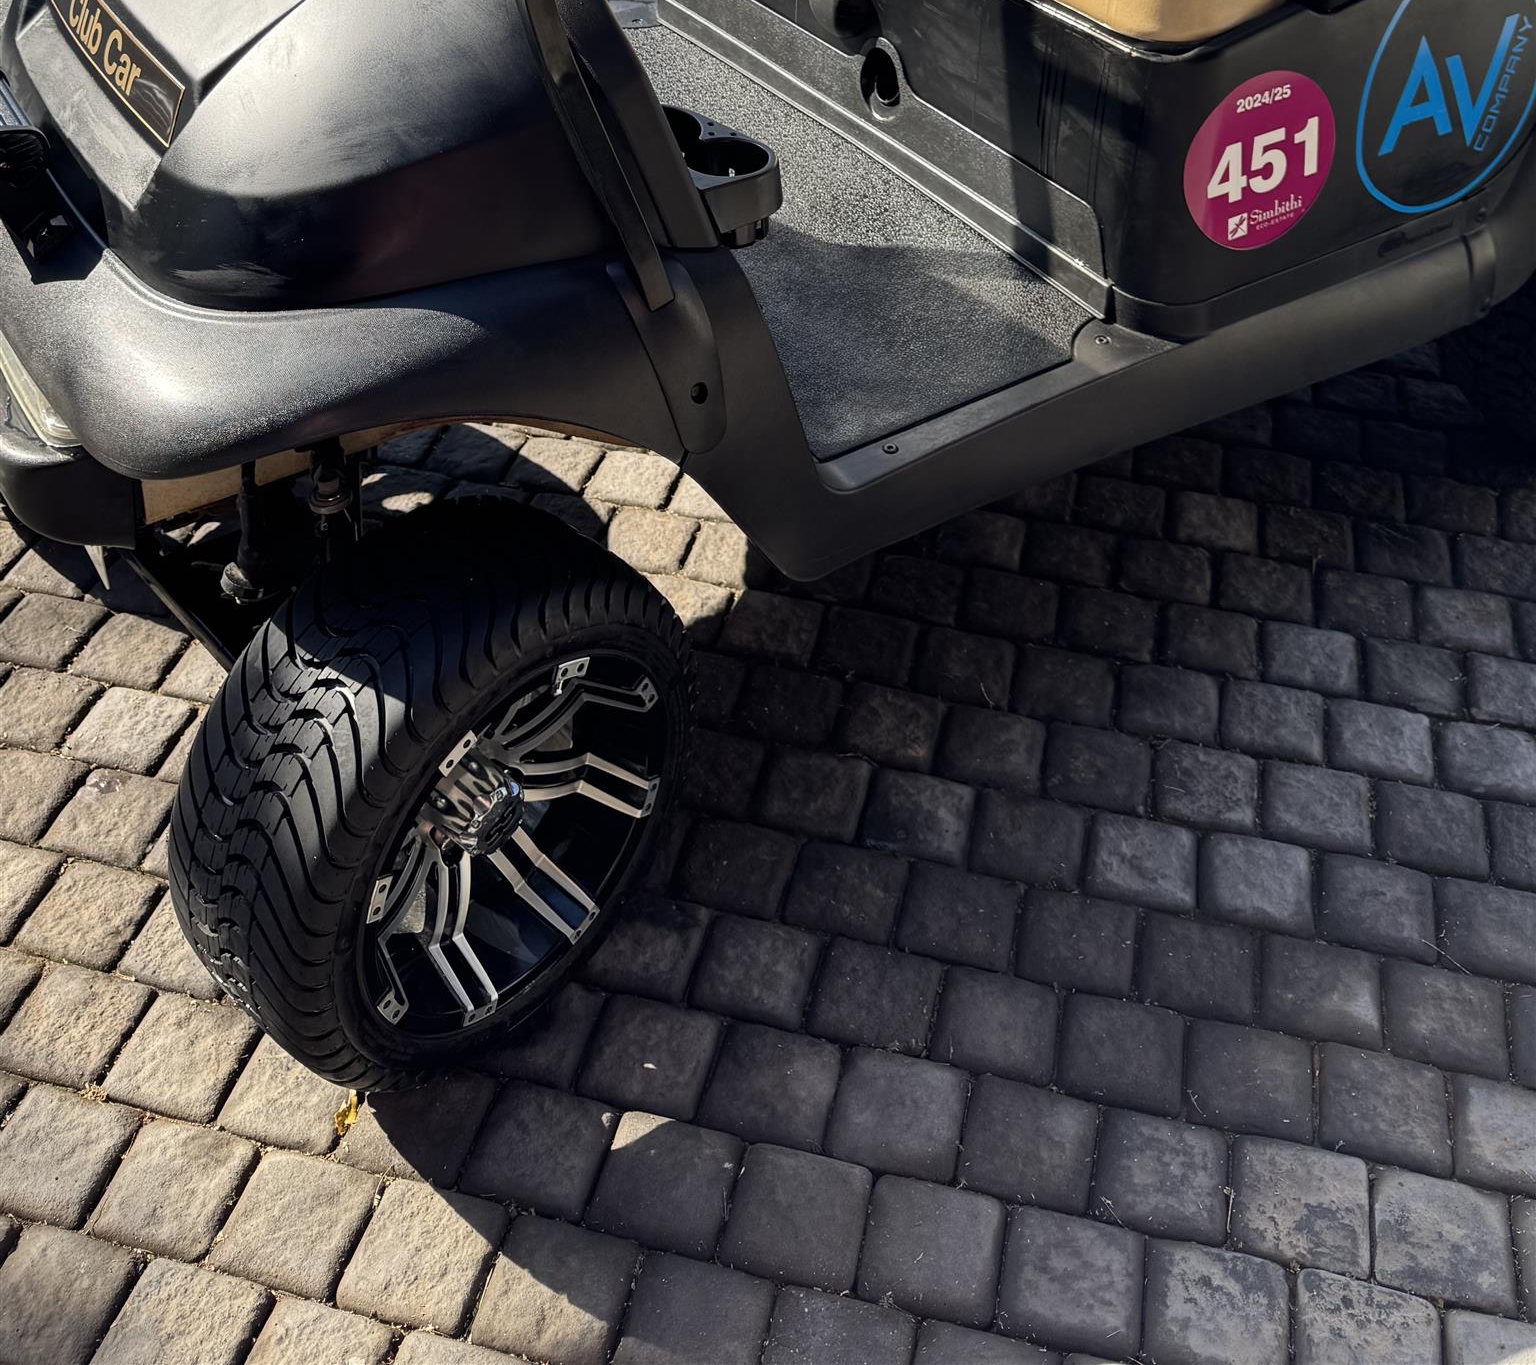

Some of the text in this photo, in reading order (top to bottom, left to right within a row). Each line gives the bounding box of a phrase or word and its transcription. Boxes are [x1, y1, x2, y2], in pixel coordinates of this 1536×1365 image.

[103, 29, 142, 97] Car
[1236, 84, 1292, 113] 2024/25
[1377, 12, 1521, 156] AV
[1472, 15, 1534, 153] COMPANY
[1206, 115, 1320, 204] 451
[1249, 193, 1303, 225] Simbithi
